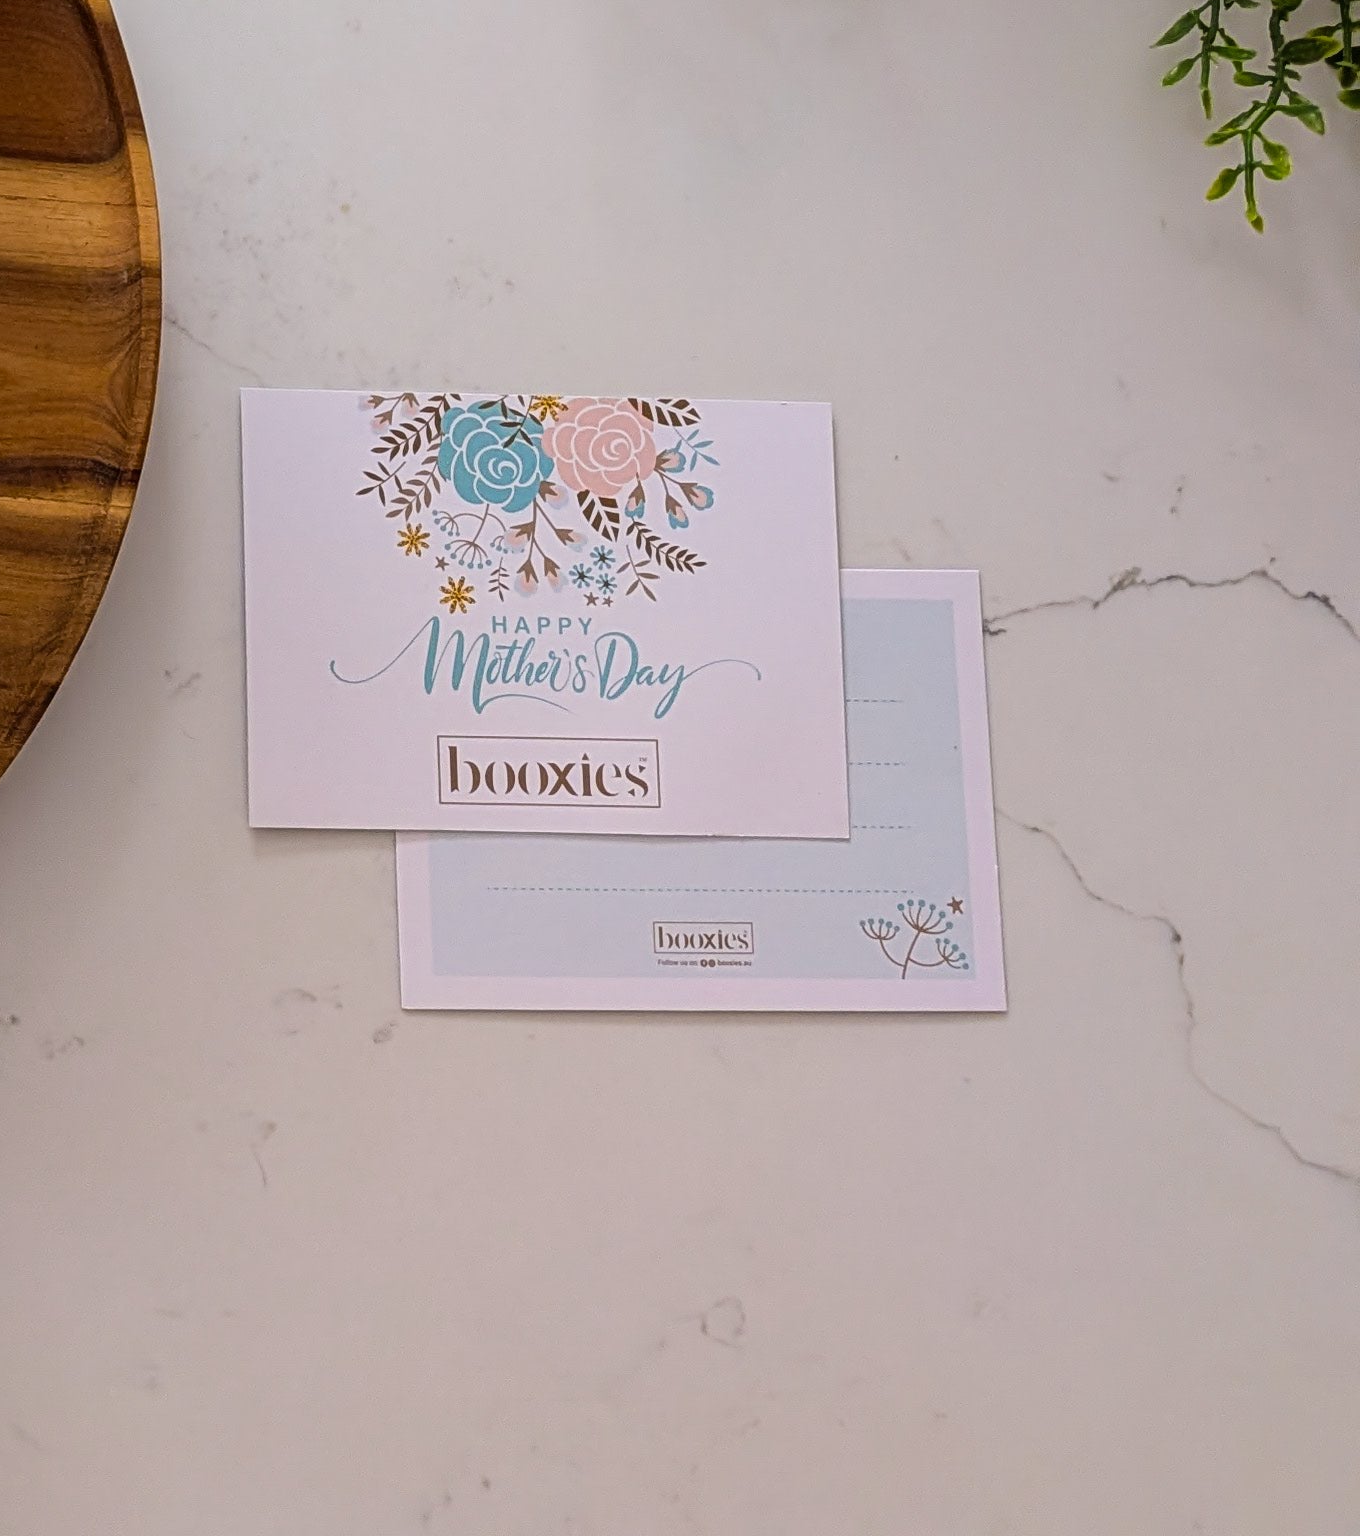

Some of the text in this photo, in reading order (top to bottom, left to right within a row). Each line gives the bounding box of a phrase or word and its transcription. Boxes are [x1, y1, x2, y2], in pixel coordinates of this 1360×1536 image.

[491, 615, 593, 635] HAPPY
[372, 615, 718, 720] Mother's Day
[447, 745, 650, 798] booxies
[658, 925, 749, 950] booxies
